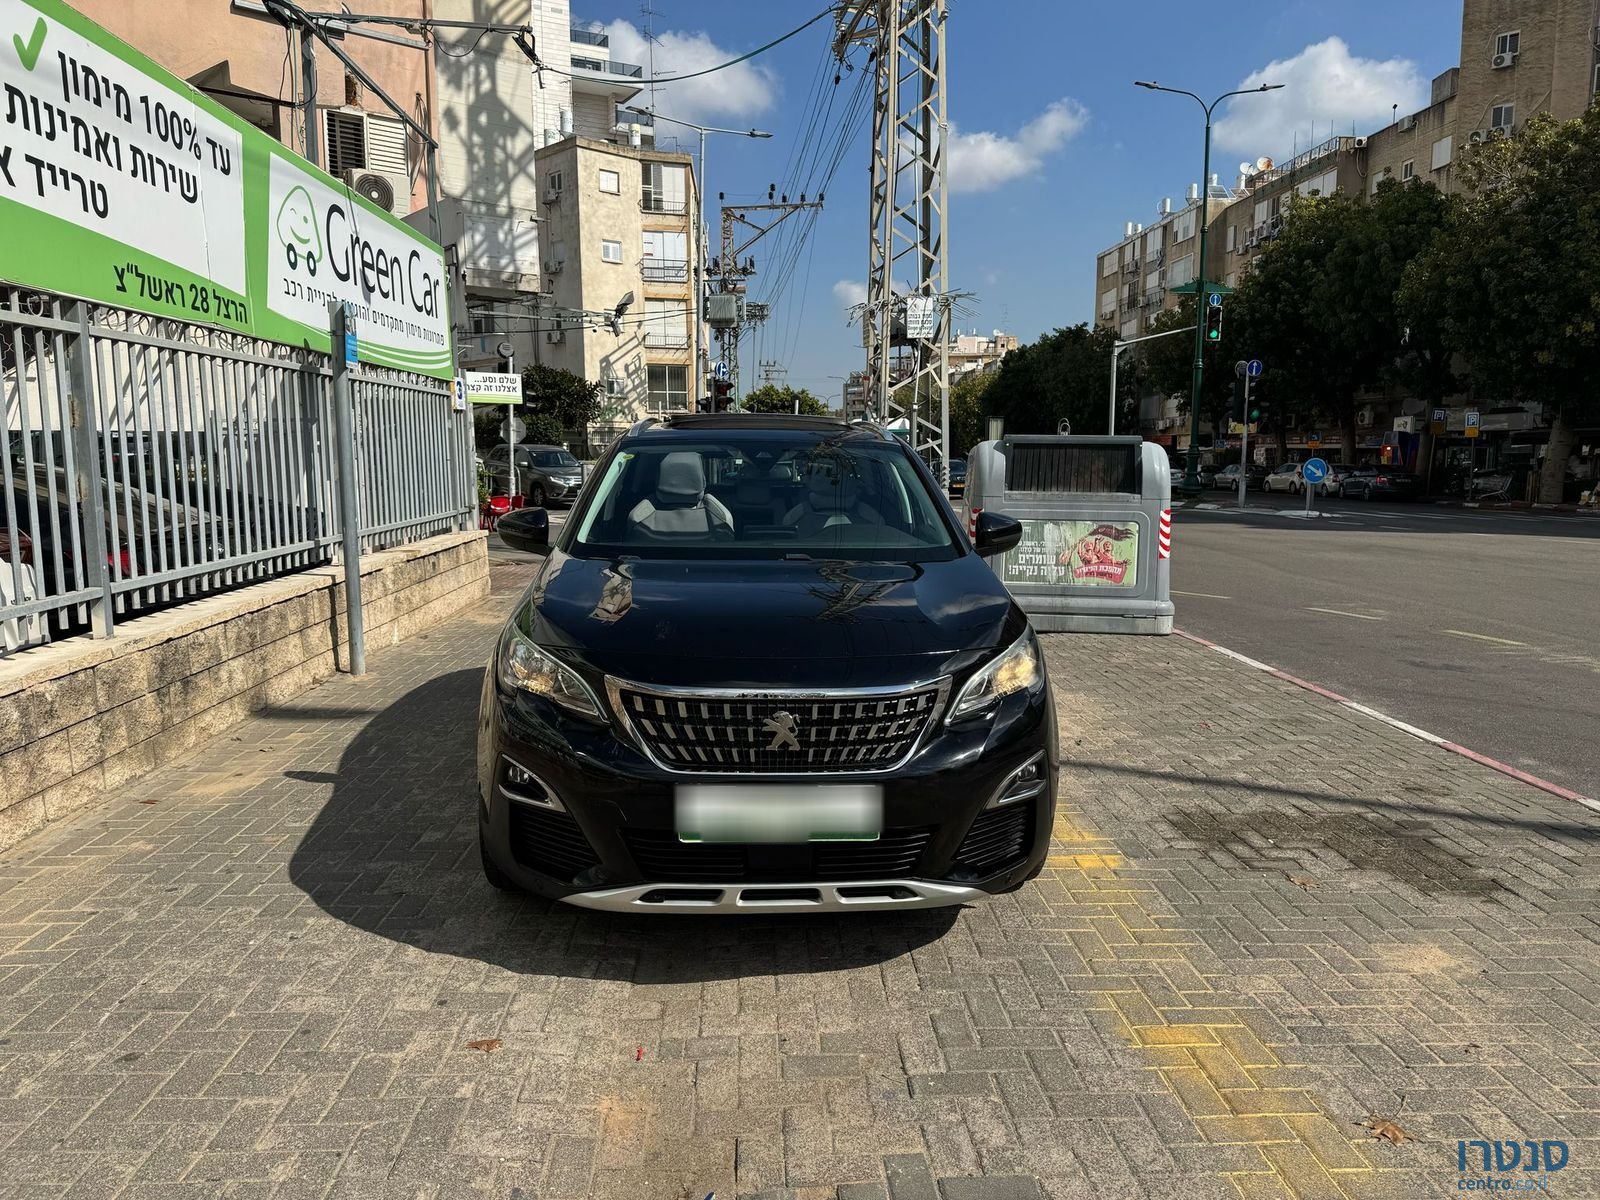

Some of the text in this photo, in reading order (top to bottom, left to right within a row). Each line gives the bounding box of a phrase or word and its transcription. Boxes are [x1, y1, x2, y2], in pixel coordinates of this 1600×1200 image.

[58, 50, 231, 176] עד 100% מימון
[4, 82, 198, 204] שירות ואמינות
[24, 153, 109, 219] טרייד
[325, 203, 440, 319] Green Car
[189, 283, 210, 314] 28
[283, 277, 304, 300] רכב
[212, 288, 248, 324] הרצל
[372, 310, 404, 333] מתקדמים
[405, 321, 422, 339] מימון
[483, 384, 493, 392] זה
[495, 384, 518, 393] אצלנו
[499, 376, 517, 384] שלם
[1008, 564, 1038, 577] נקייה!
[1018, 553, 1056, 565] שומרים
